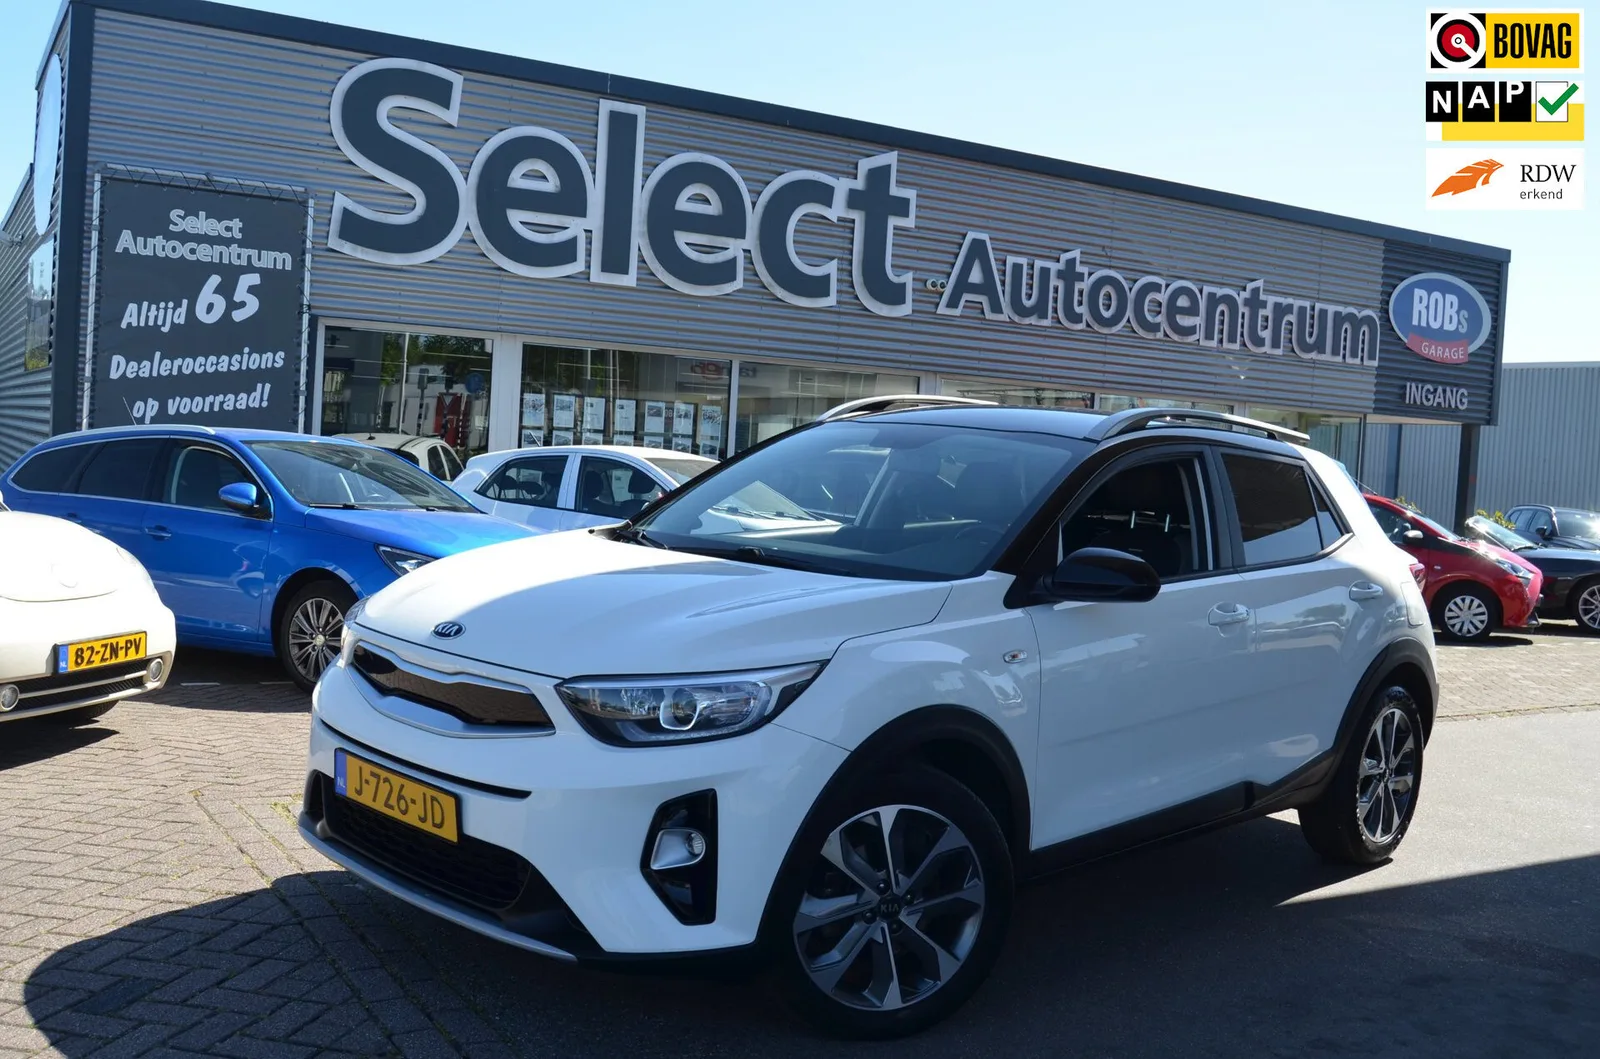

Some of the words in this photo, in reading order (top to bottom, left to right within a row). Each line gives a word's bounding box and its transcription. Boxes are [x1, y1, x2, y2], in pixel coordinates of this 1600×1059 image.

[168, 208, 243, 239] Select
[328, 58, 917, 317] Select
[936, 231, 1380, 366] Autocentrum
[115, 229, 292, 271] Autocentrum
[120, 299, 188, 333] Altijd
[195, 273, 261, 324] 65
[109, 347, 285, 380] Dealeroccasions
[1421, 342, 1465, 360] GARAGE
[132, 398, 160, 425] op
[167, 383, 272, 416] voorraad!
[1405, 381, 1469, 410] INGANG
[434, 623, 460, 636] KIA
[74, 637, 142, 668] 82-ZN-PV
[354, 765, 445, 829] J-726-JD
[880, 903, 899, 914] KIA
